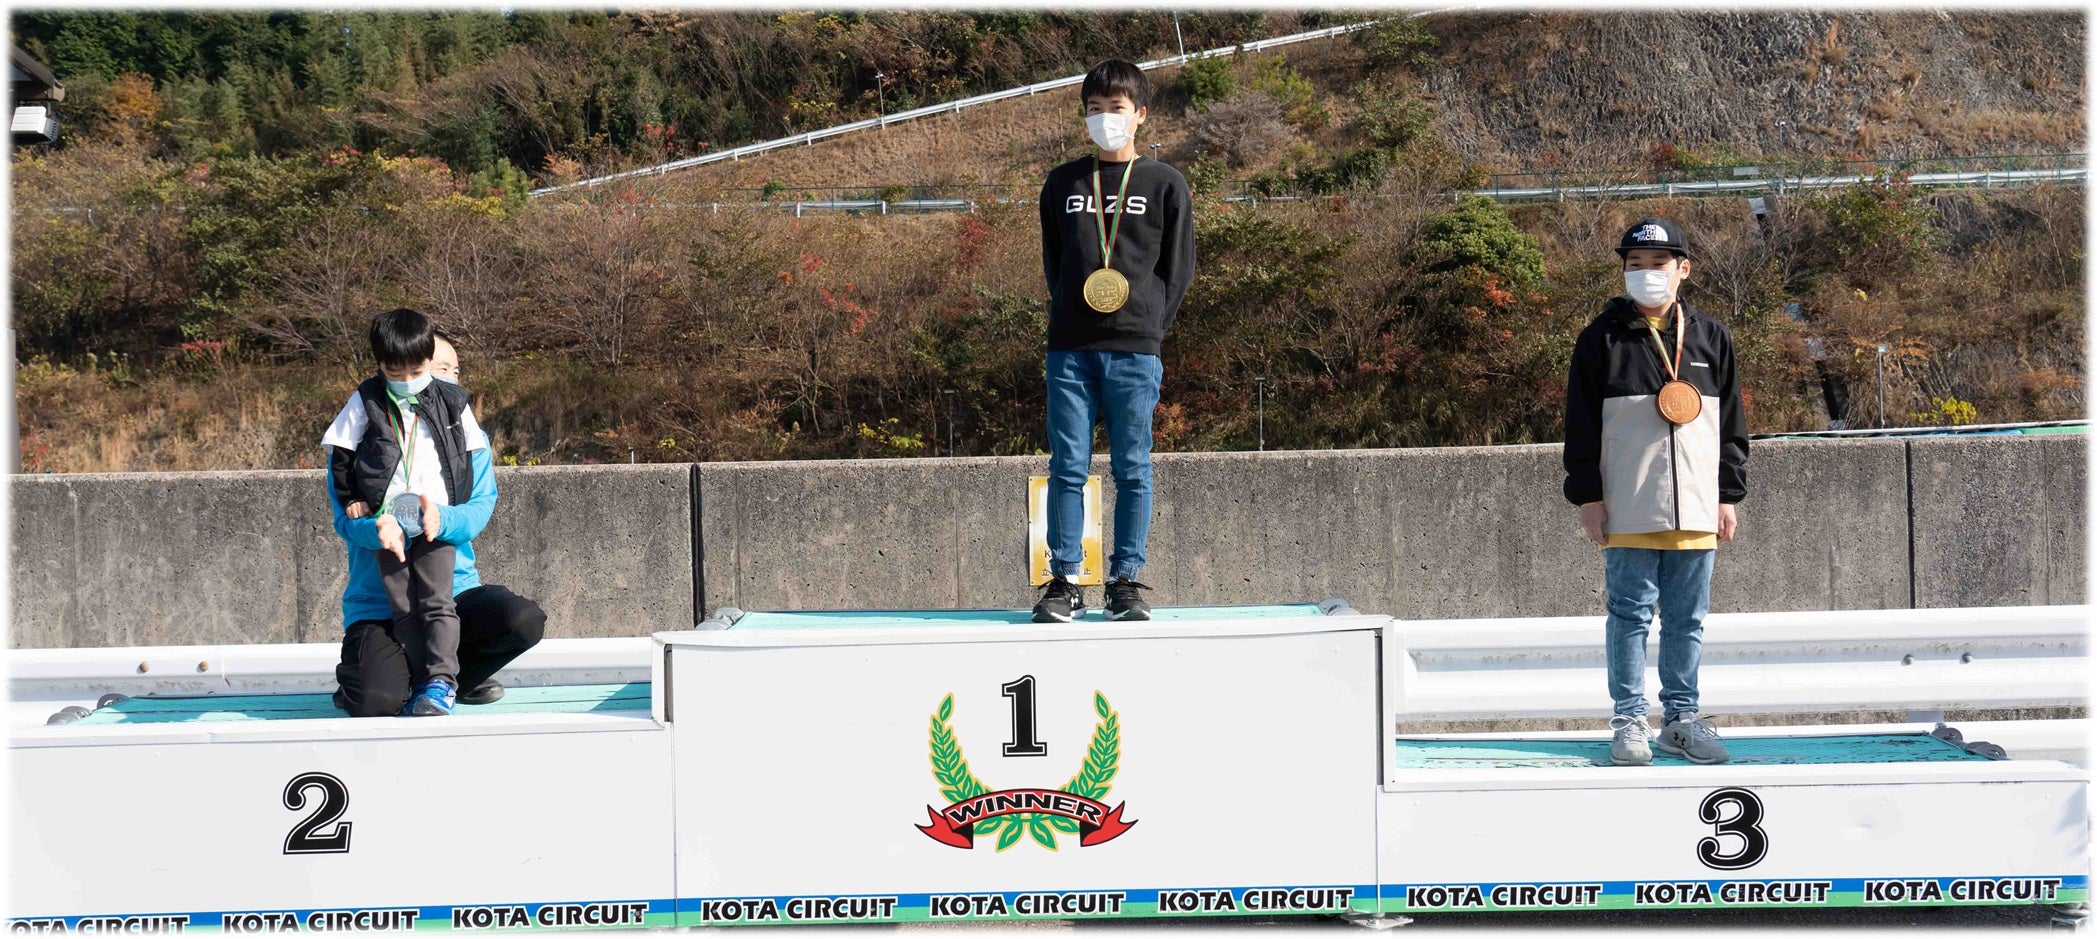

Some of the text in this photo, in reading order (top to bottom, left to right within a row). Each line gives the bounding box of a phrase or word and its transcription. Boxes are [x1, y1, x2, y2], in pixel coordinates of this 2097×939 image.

[1066, 195, 1148, 215] GLZS
[1002, 674, 1048, 757] 1
[283, 772, 352, 855] 2
[949, 793, 1103, 824] WINNER
[1697, 787, 1769, 870] 3
[1160, 889, 1353, 911] KOTA CIRCUIT
[1408, 885, 1601, 907] KOTA CIRCUIT
[1636, 882, 1830, 904] KOTA CIRCUIT
[1866, 880, 2060, 901] KOTA CIRCUIT
[702, 898, 896, 921] KOTA CIRCUIT
[931, 893, 1125, 916] KOTA CIRCUIT
[6, 917, 188, 936] OTA CIRCUIT
[224, 911, 418, 933] KOTA CIRCUIT
[453, 904, 647, 928] KOTA CIRCUIT
